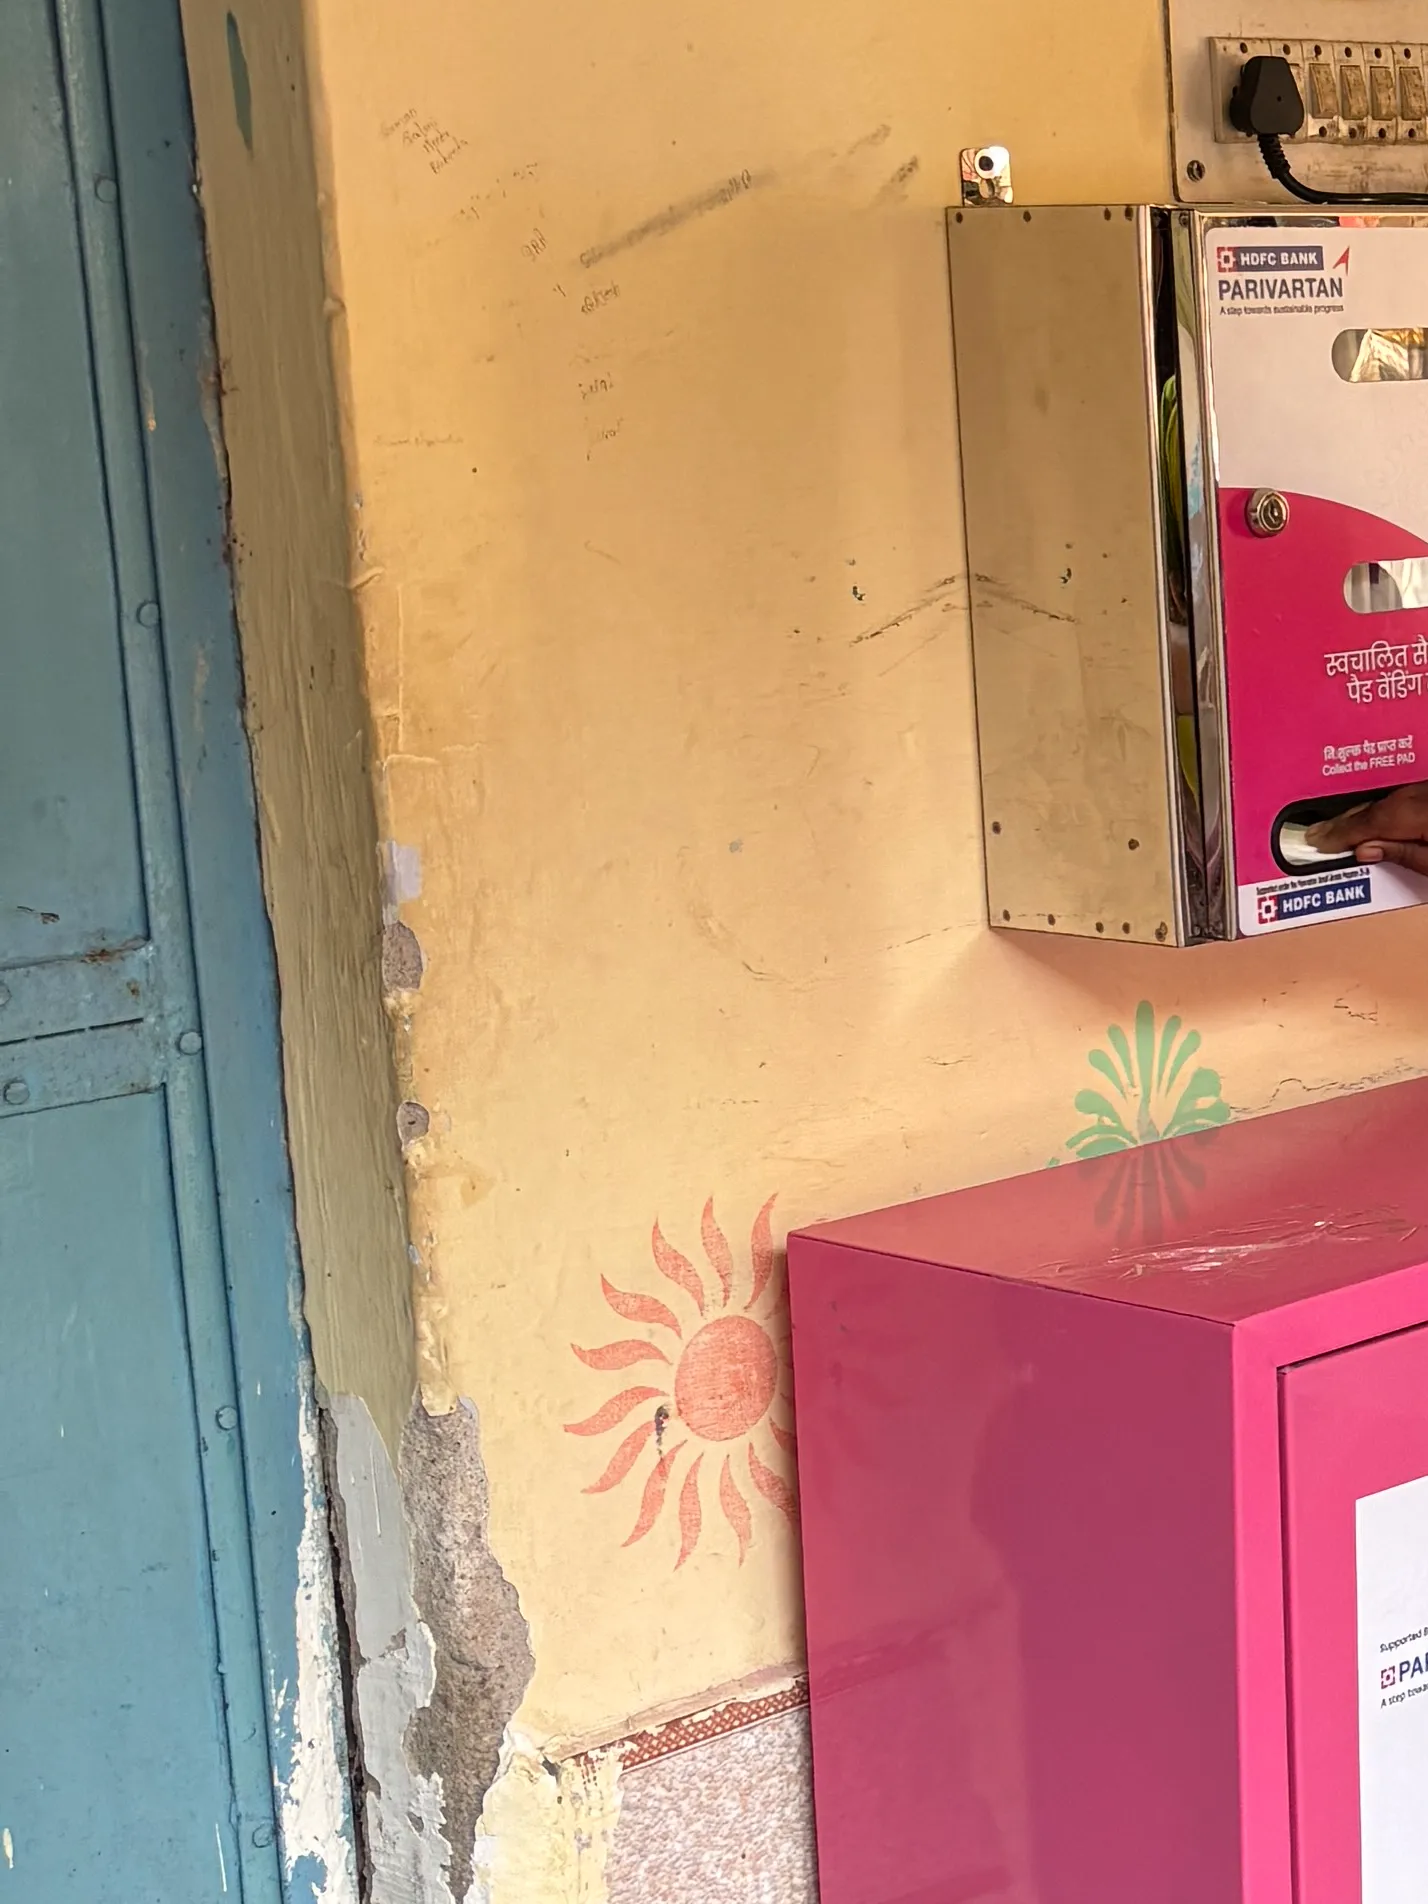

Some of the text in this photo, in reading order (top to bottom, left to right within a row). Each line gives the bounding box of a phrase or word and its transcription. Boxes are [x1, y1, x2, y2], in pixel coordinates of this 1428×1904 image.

[1239, 251, 1317, 265] HDFC BANK
[1218, 275, 1342, 301] PARIVARTAN
[1323, 637, 1408, 678] स्वचालित
[1346, 671, 1372, 705] पैड
[1375, 666, 1422, 702] वेंडिंग
[1369, 755, 1394, 769] FREE
[1396, 751, 1415, 765] PAD
[1282, 884, 1364, 913] HDFC BANK
[1381, 1698, 1386, 1708] A
[1389, 1690, 1404, 1706] step
